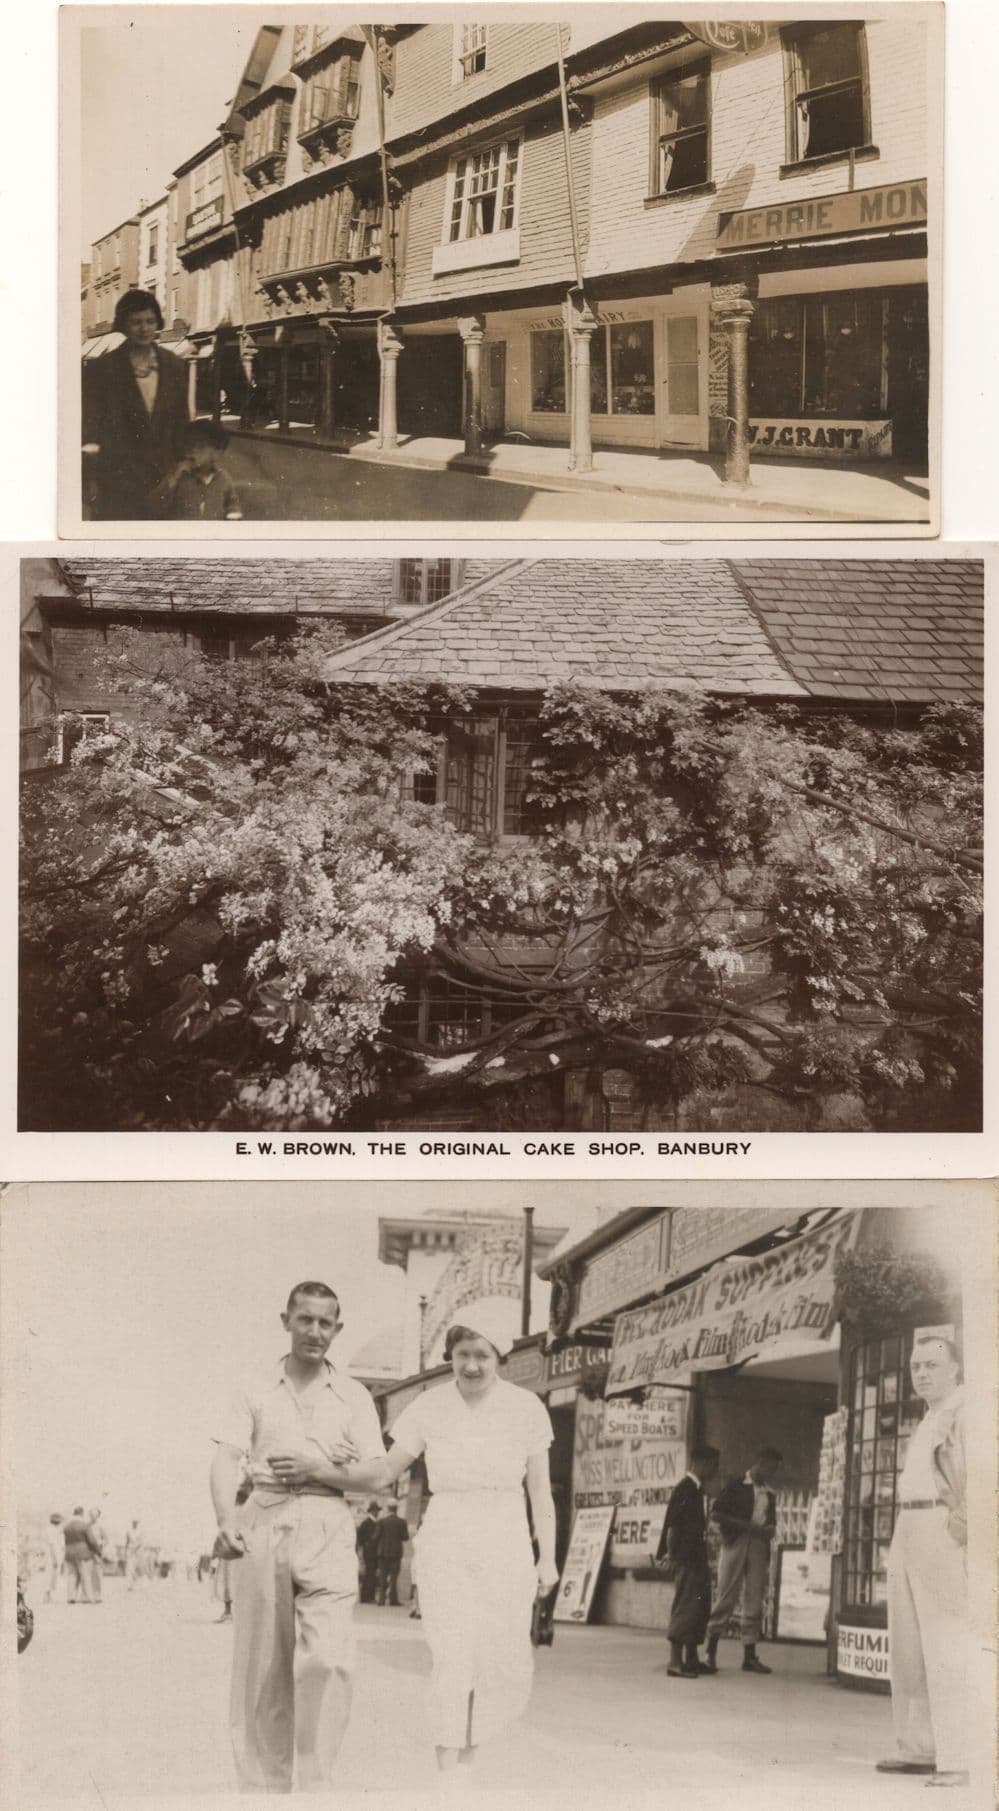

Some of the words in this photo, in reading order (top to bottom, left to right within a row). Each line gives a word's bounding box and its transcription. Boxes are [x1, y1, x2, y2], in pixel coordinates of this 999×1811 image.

[724, 200, 834, 242] MERRIE
[859, 184, 927, 225] MON
[551, 1345, 583, 1376] PIER
[608, 1420, 639, 1434] SPEED
[641, 1421, 677, 1436] BOATS
[614, 1519, 651, 1545] HERE
